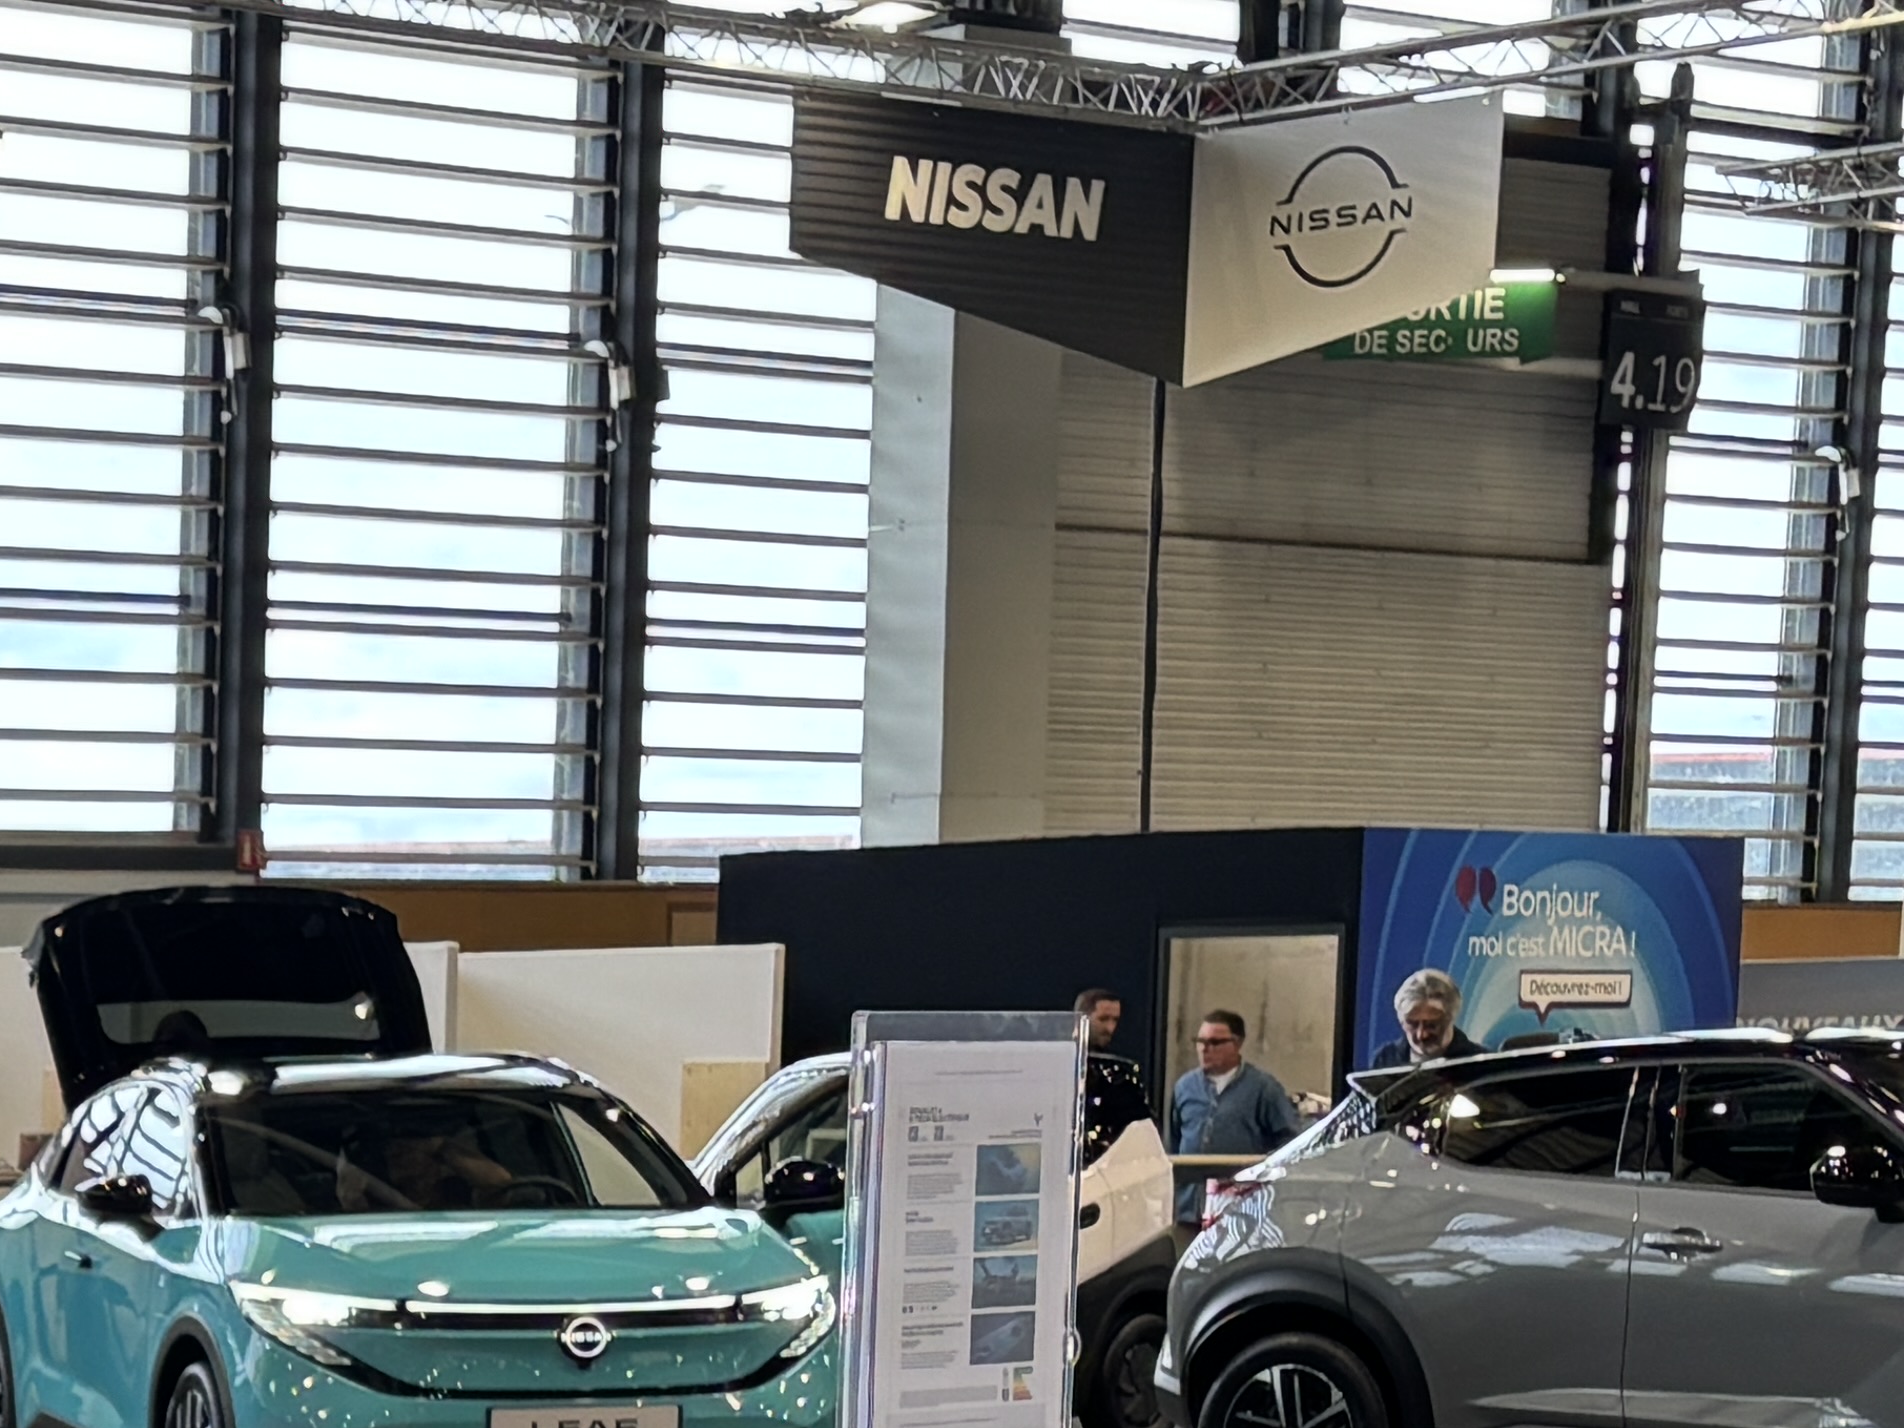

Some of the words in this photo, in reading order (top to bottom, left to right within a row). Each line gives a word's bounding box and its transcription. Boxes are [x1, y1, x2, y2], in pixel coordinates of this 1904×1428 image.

[884, 154, 1106, 243] NISSAN
[1269, 195, 1414, 239] NISSAN
[1353, 330, 1389, 355] DE
[1395, 327, 1520, 354] SECURS
[1609, 350, 1696, 414] 4.19
[1501, 882, 1603, 927] Bonjour,
[1506, 933, 1546, 958] c'est
[1548, 924, 1627, 958] MICRA
